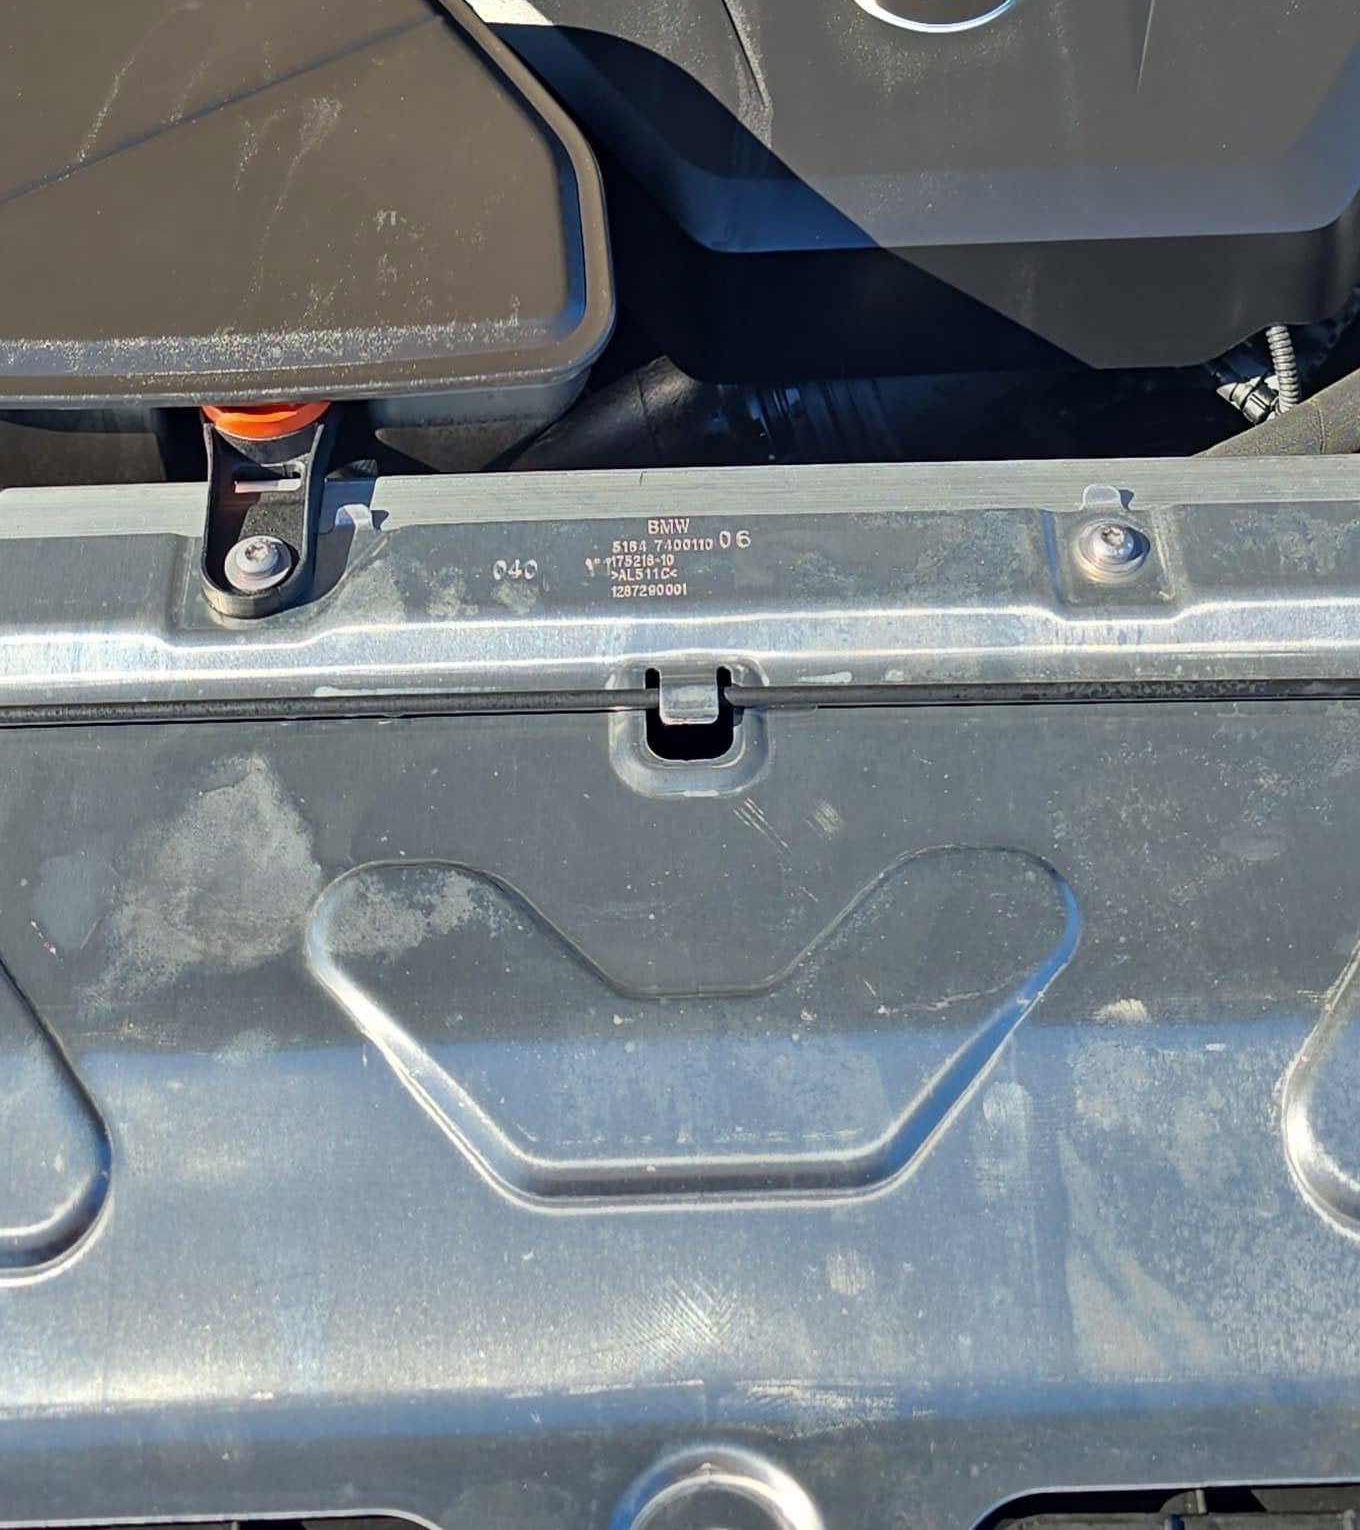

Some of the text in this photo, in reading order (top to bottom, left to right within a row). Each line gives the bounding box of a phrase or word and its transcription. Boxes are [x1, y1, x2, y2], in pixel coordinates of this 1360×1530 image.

[647, 518, 690, 534] BMW
[612, 530, 752, 554] 5164 7400110 06
[493, 559, 538, 581] 040
